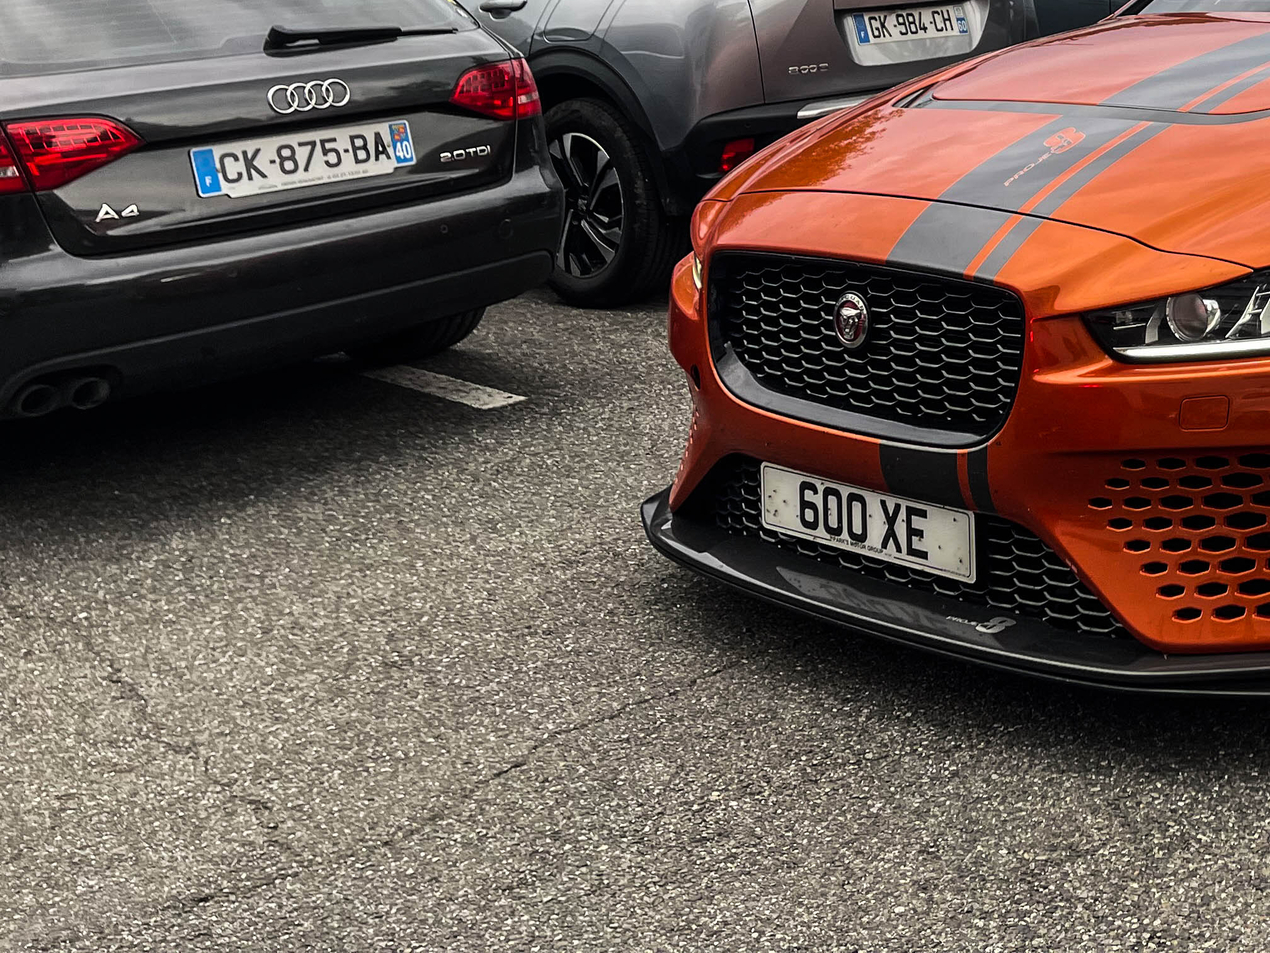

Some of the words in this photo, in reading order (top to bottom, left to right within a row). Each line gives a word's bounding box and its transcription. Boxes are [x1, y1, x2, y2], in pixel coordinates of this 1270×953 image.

[868, 9, 954, 39] GK-984-CH
[205, 176, 212, 188] F
[218, 132, 392, 184] CK-875-BA
[395, 140, 412, 160] 40
[95, 203, 139, 223] A4
[799, 480, 867, 544] 600
[879, 499, 929, 561] XE
